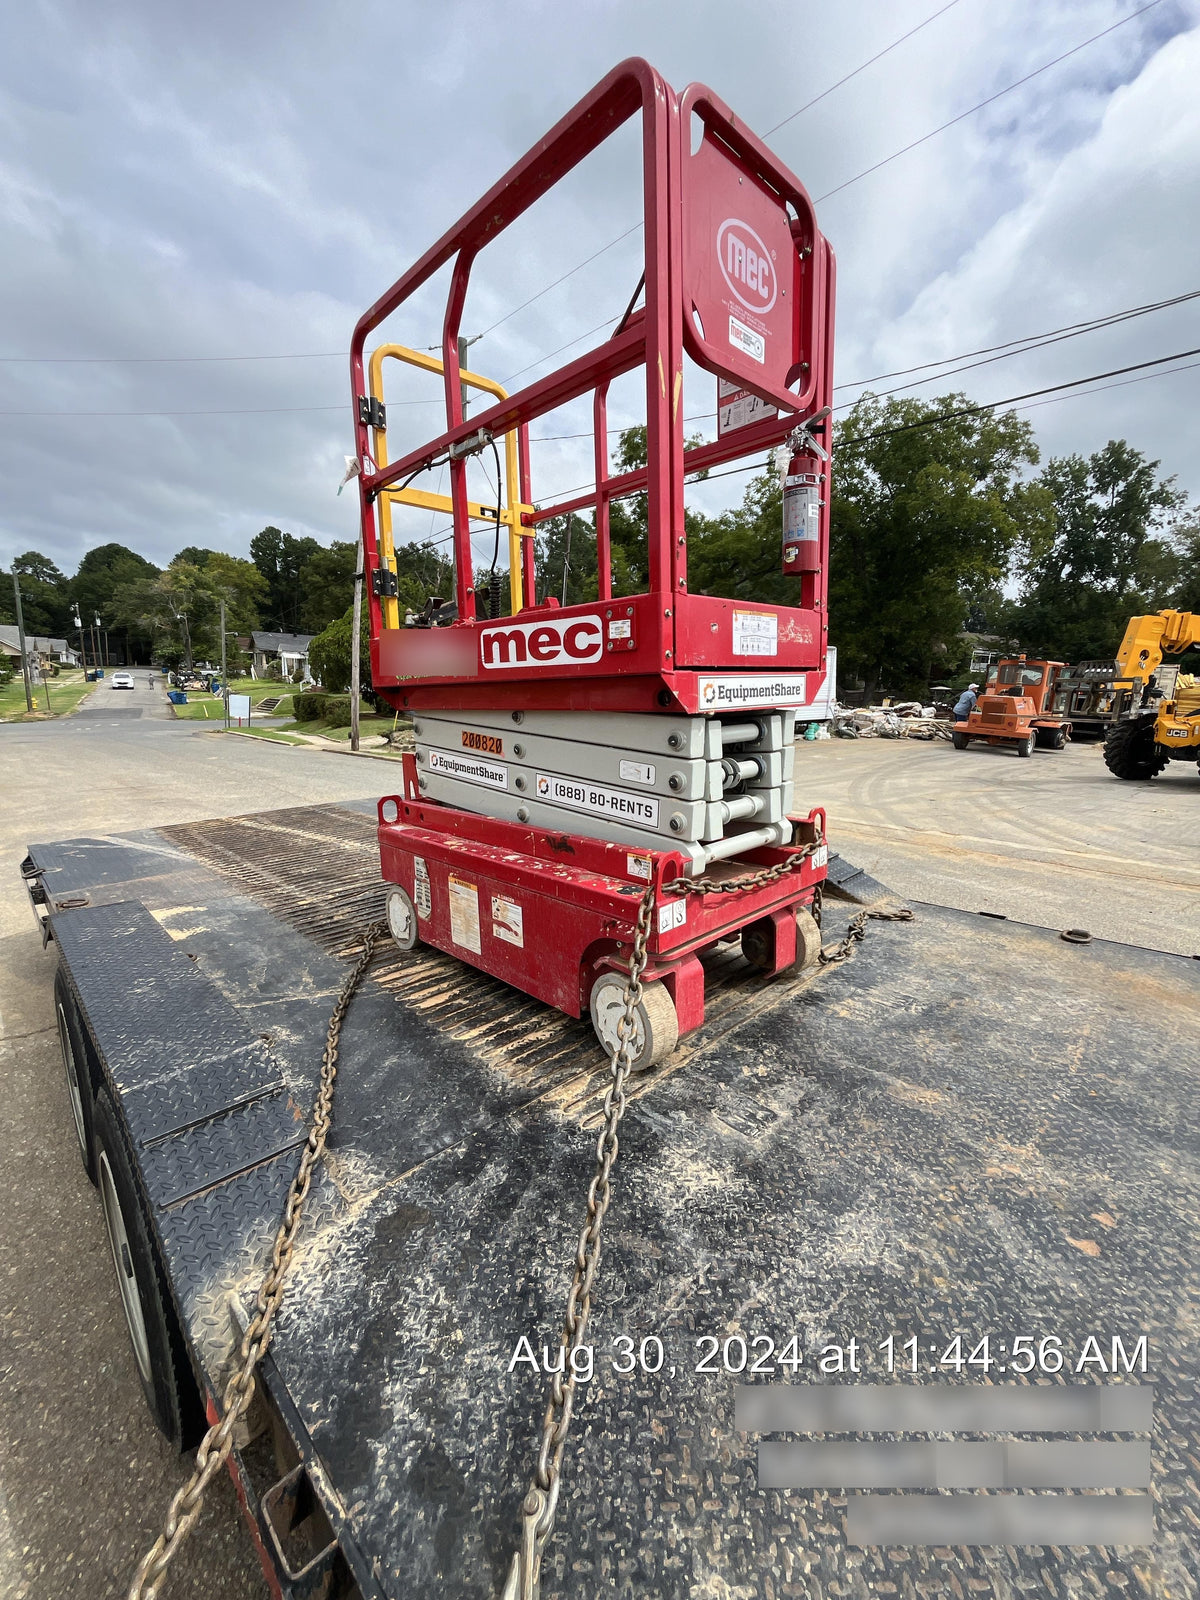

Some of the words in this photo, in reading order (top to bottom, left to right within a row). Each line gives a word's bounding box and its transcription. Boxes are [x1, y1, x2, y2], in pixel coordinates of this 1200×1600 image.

[727, 232, 769, 300] mec
[482, 621, 602, 664] mec
[717, 683, 801, 703] EquipmentShare
[462, 730, 503, 754] 200820
[1166, 729, 1188, 738] JCB
[438, 756, 504, 783] EquipmentShare
[555, 782, 586, 804] (888)
[589, 791, 653, 818] 80-RENTS
